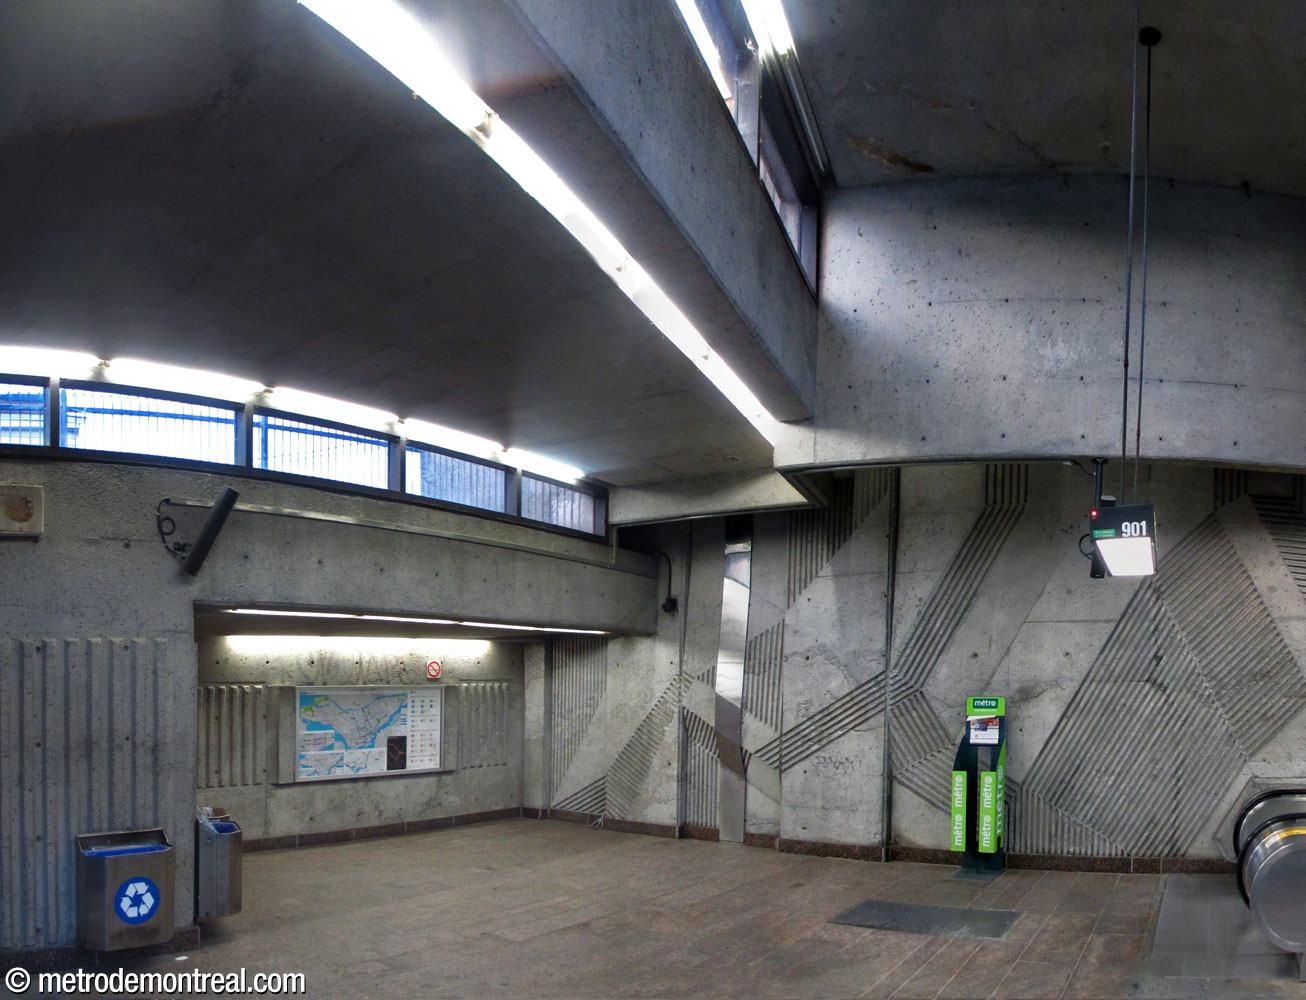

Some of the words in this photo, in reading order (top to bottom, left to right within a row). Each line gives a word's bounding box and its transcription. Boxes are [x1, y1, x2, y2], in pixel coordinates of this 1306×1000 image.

[1121, 520, 1147, 538] 901
[953, 774, 964, 808] métro
[982, 775, 993, 809] métro
[953, 813, 963, 846] métro
[981, 814, 992, 848] métro
